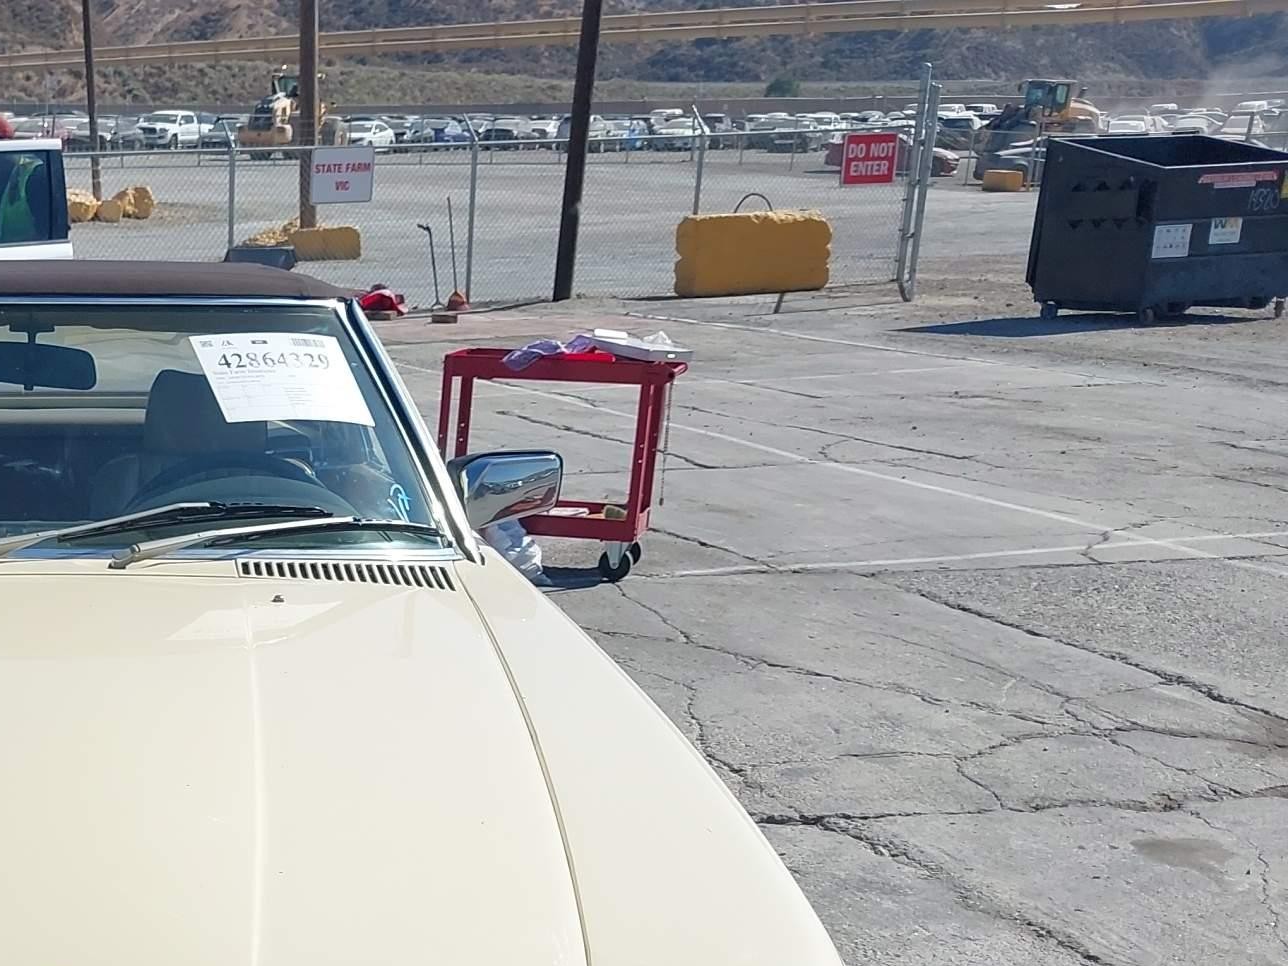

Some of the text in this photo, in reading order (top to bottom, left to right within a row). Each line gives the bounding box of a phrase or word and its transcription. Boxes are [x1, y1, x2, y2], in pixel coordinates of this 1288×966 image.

[848, 142, 895, 158] DO NOT
[315, 162, 371, 174] STATE FARM
[850, 160, 889, 176] ENTER
[335, 180, 350, 191] VIC
[218, 351, 329, 370] 42864329
